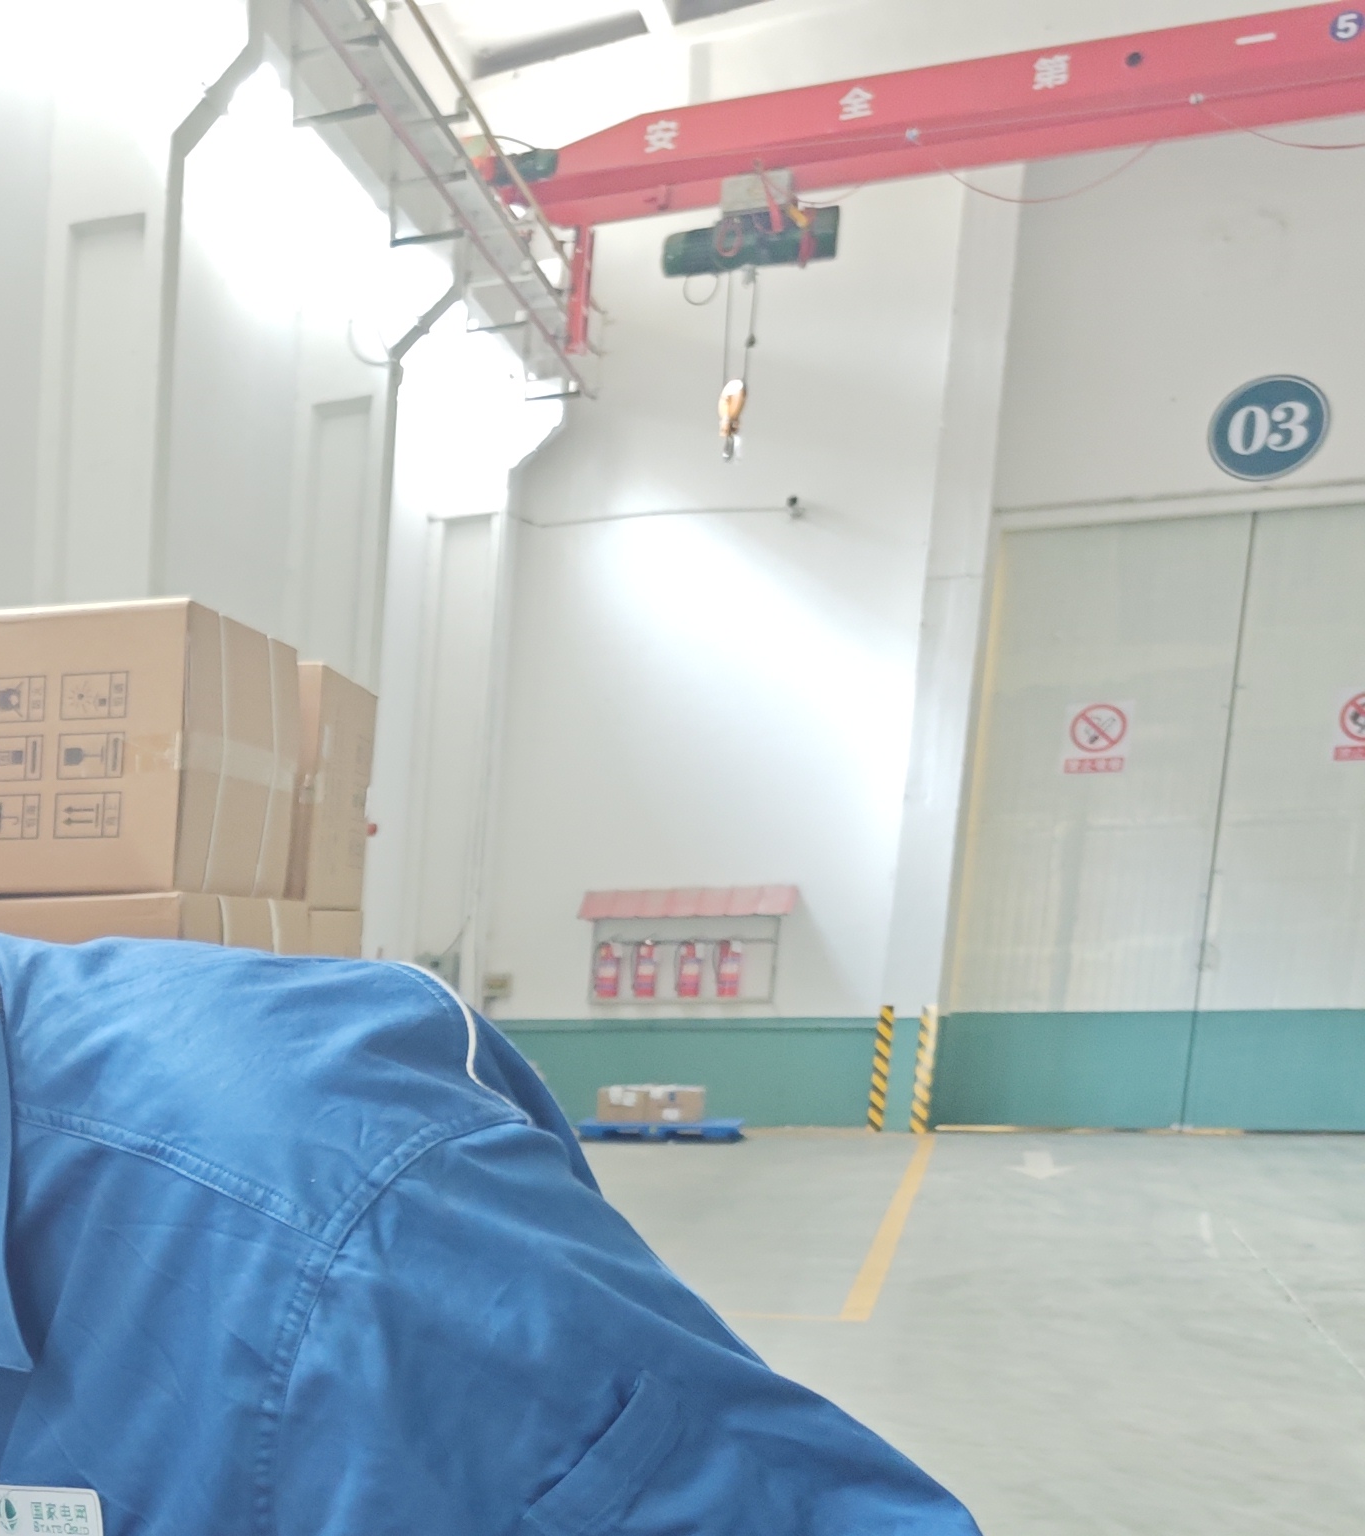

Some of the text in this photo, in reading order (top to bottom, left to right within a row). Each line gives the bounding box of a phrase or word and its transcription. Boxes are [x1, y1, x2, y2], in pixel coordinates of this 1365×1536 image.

[1335, 13, 1358, 39] 5
[1227, 401, 1309, 456] 03
[31, 1501, 88, 1523] 国家电网
